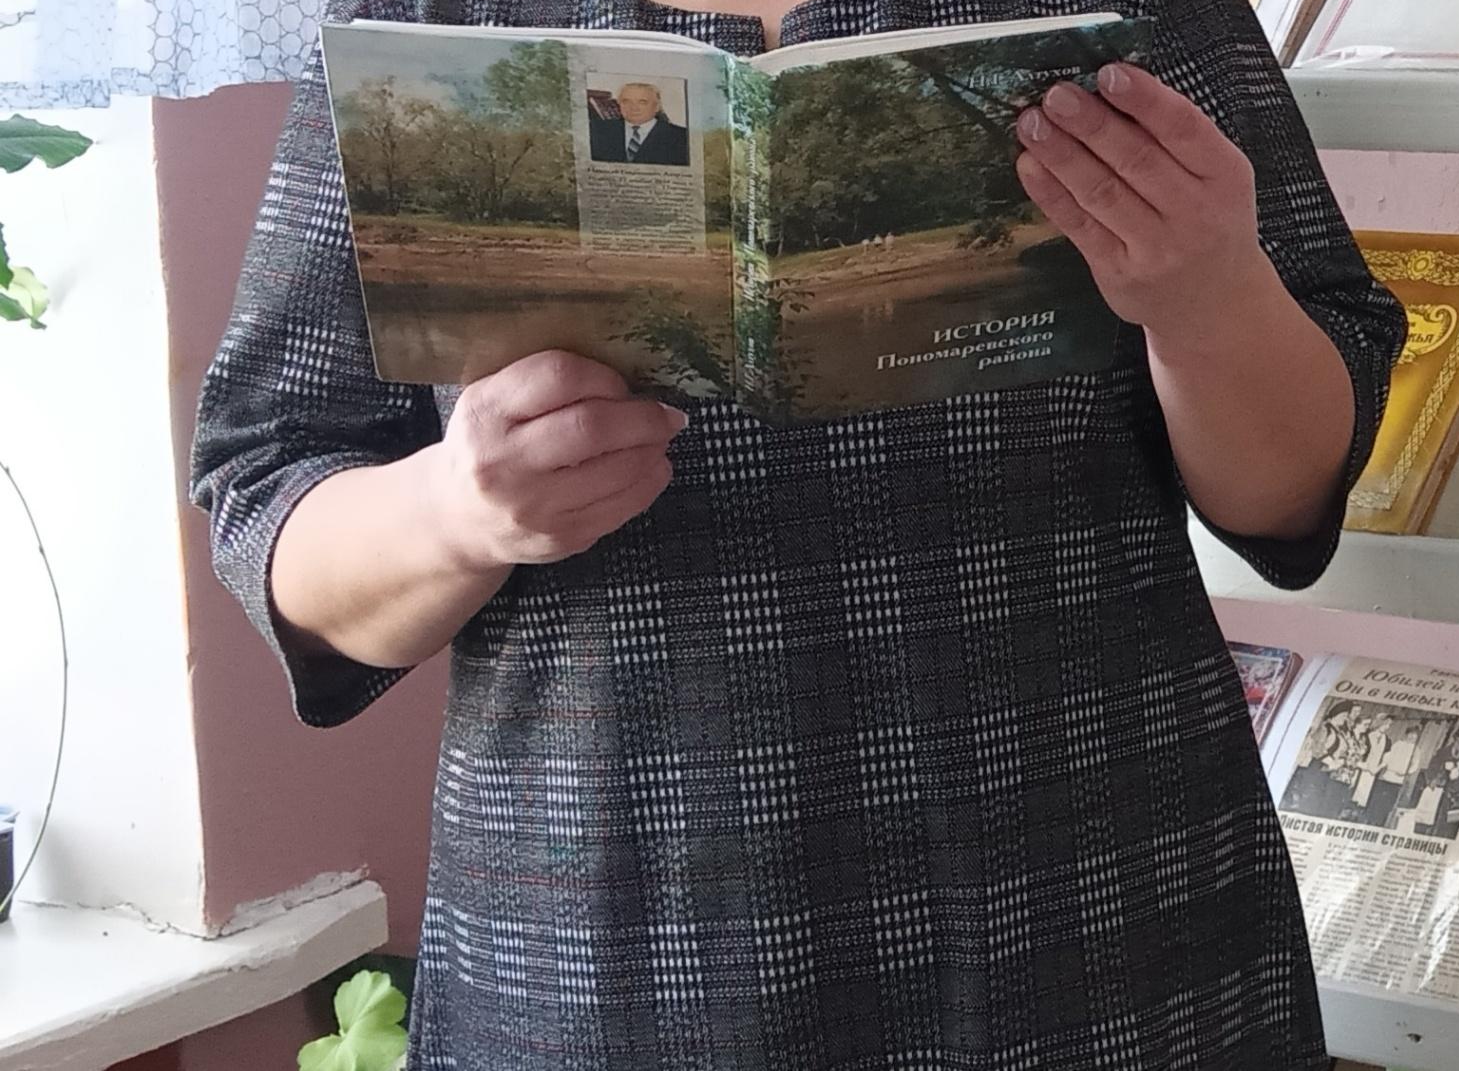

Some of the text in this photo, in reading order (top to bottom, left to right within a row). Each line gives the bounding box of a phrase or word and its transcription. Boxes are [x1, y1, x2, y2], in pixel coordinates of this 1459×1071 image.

[933, 310, 1056, 344] ИСТОРИЯ
[876, 331, 1054, 370] Пономаревского
[977, 346, 1052, 370] района
[1333, 680, 1366, 697] Он
[1383, 687, 1446, 711] новых
[1361, 668, 1452, 700] Юбилей
[1325, 820, 1379, 844] истории
[1381, 831, 1448, 856] страницы
